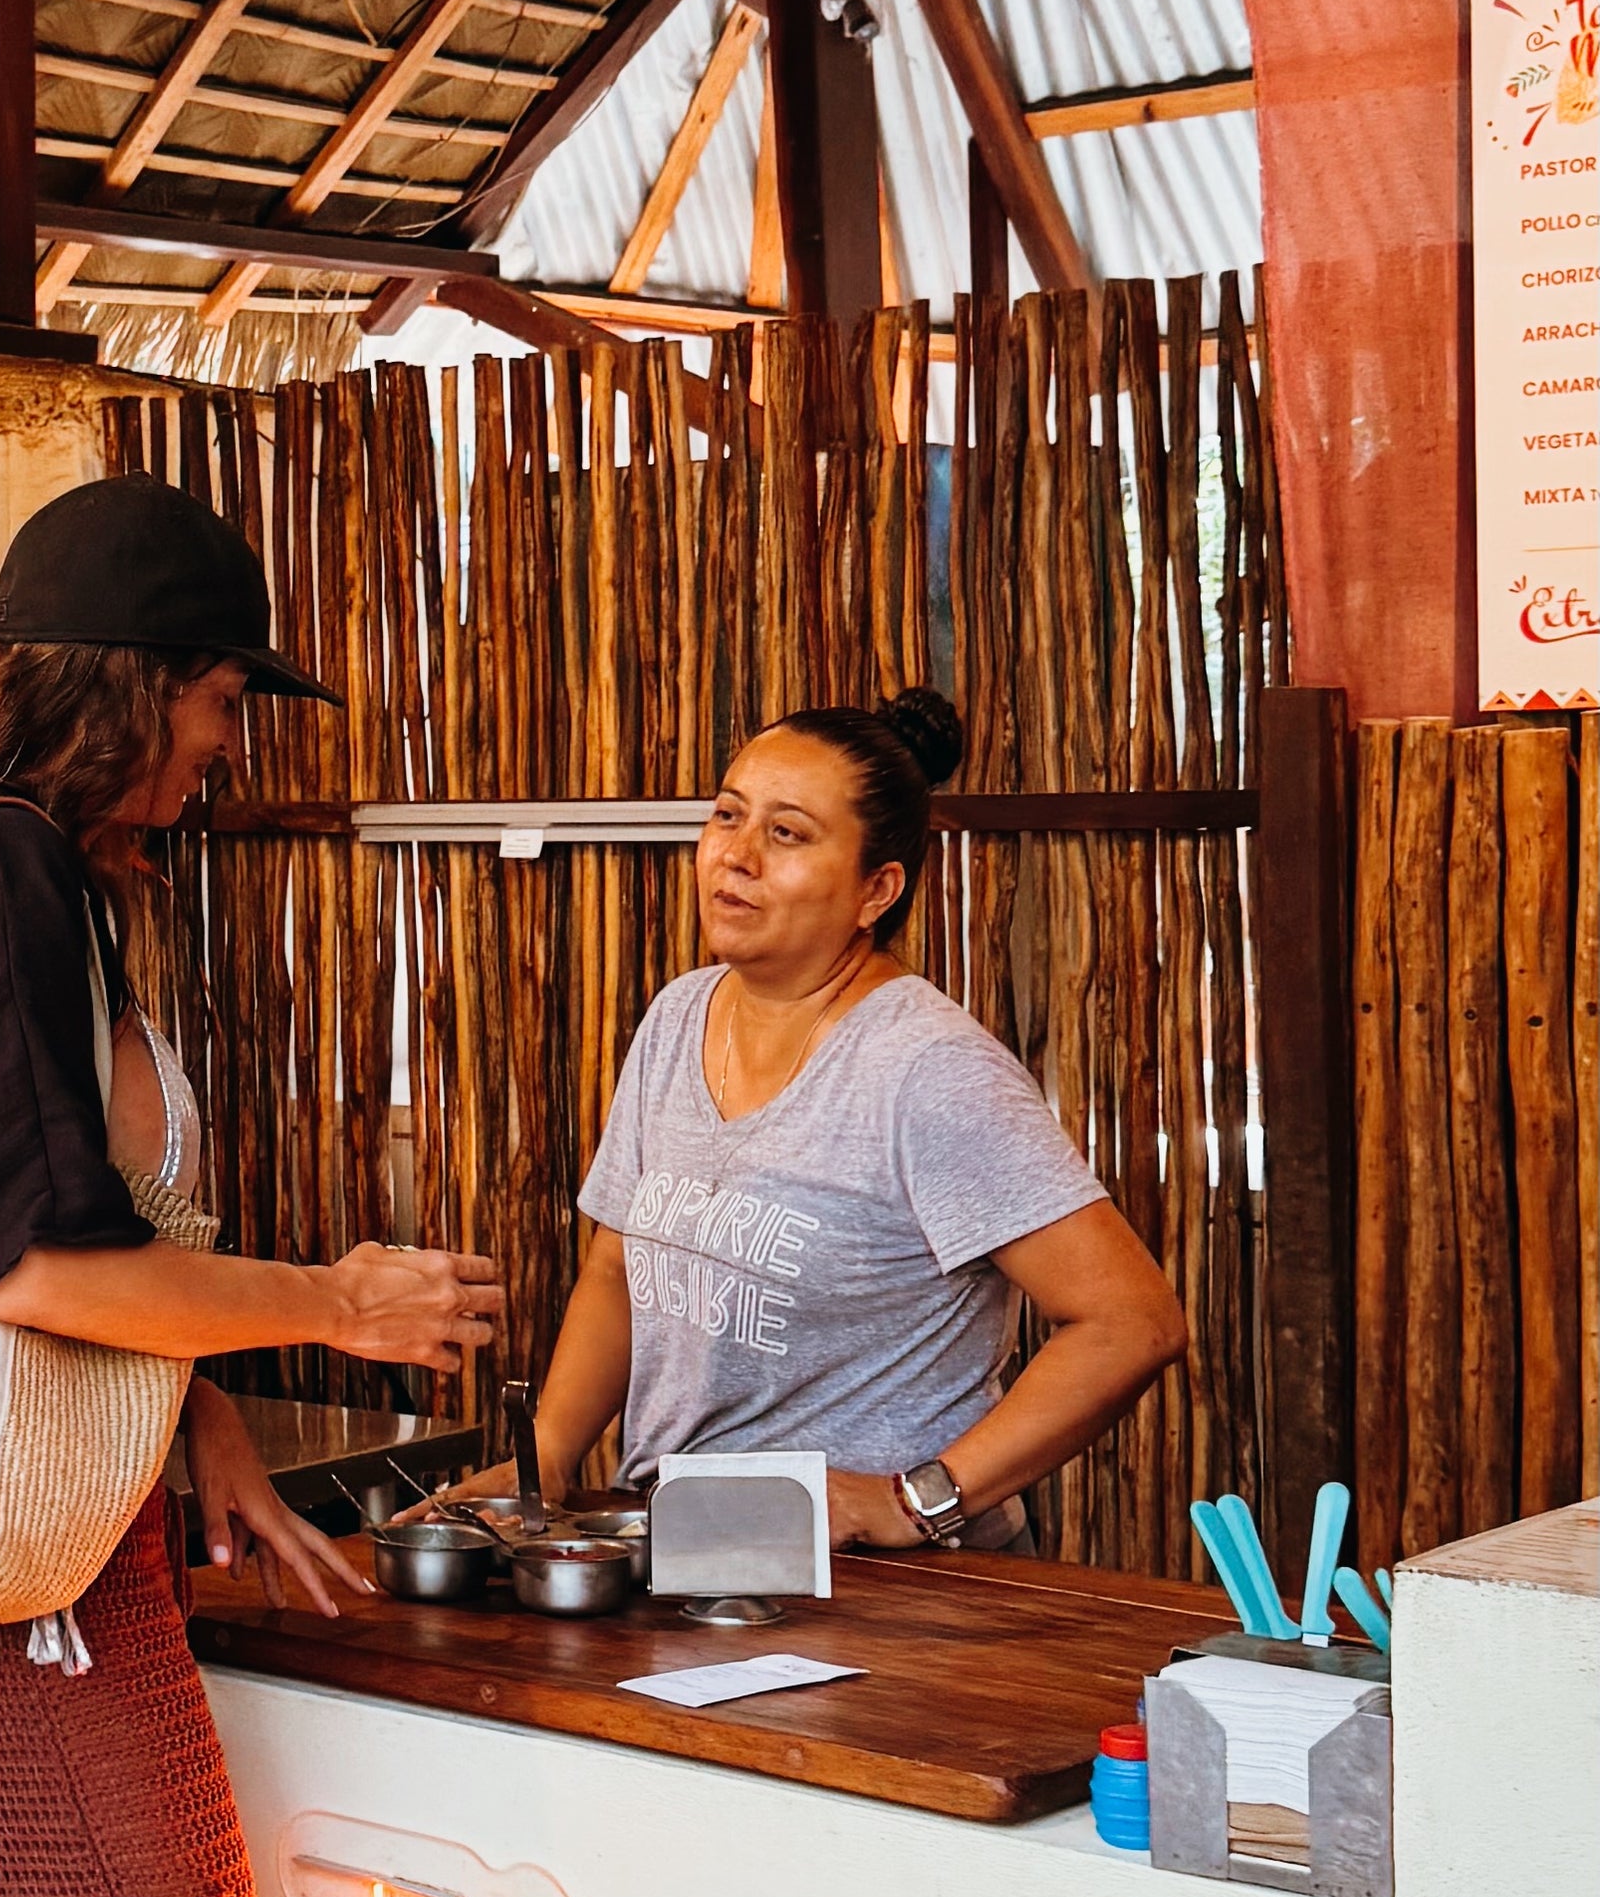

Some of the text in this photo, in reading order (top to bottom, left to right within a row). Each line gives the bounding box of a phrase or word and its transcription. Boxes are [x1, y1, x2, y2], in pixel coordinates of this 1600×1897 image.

[1520, 156, 1597, 181] PASTOR
[1521, 213, 1582, 235] POLLO
[1523, 431, 1600, 451] VEGETA
[1524, 486, 1585, 506] MIXTA
[1519, 585, 1600, 644] Extr
